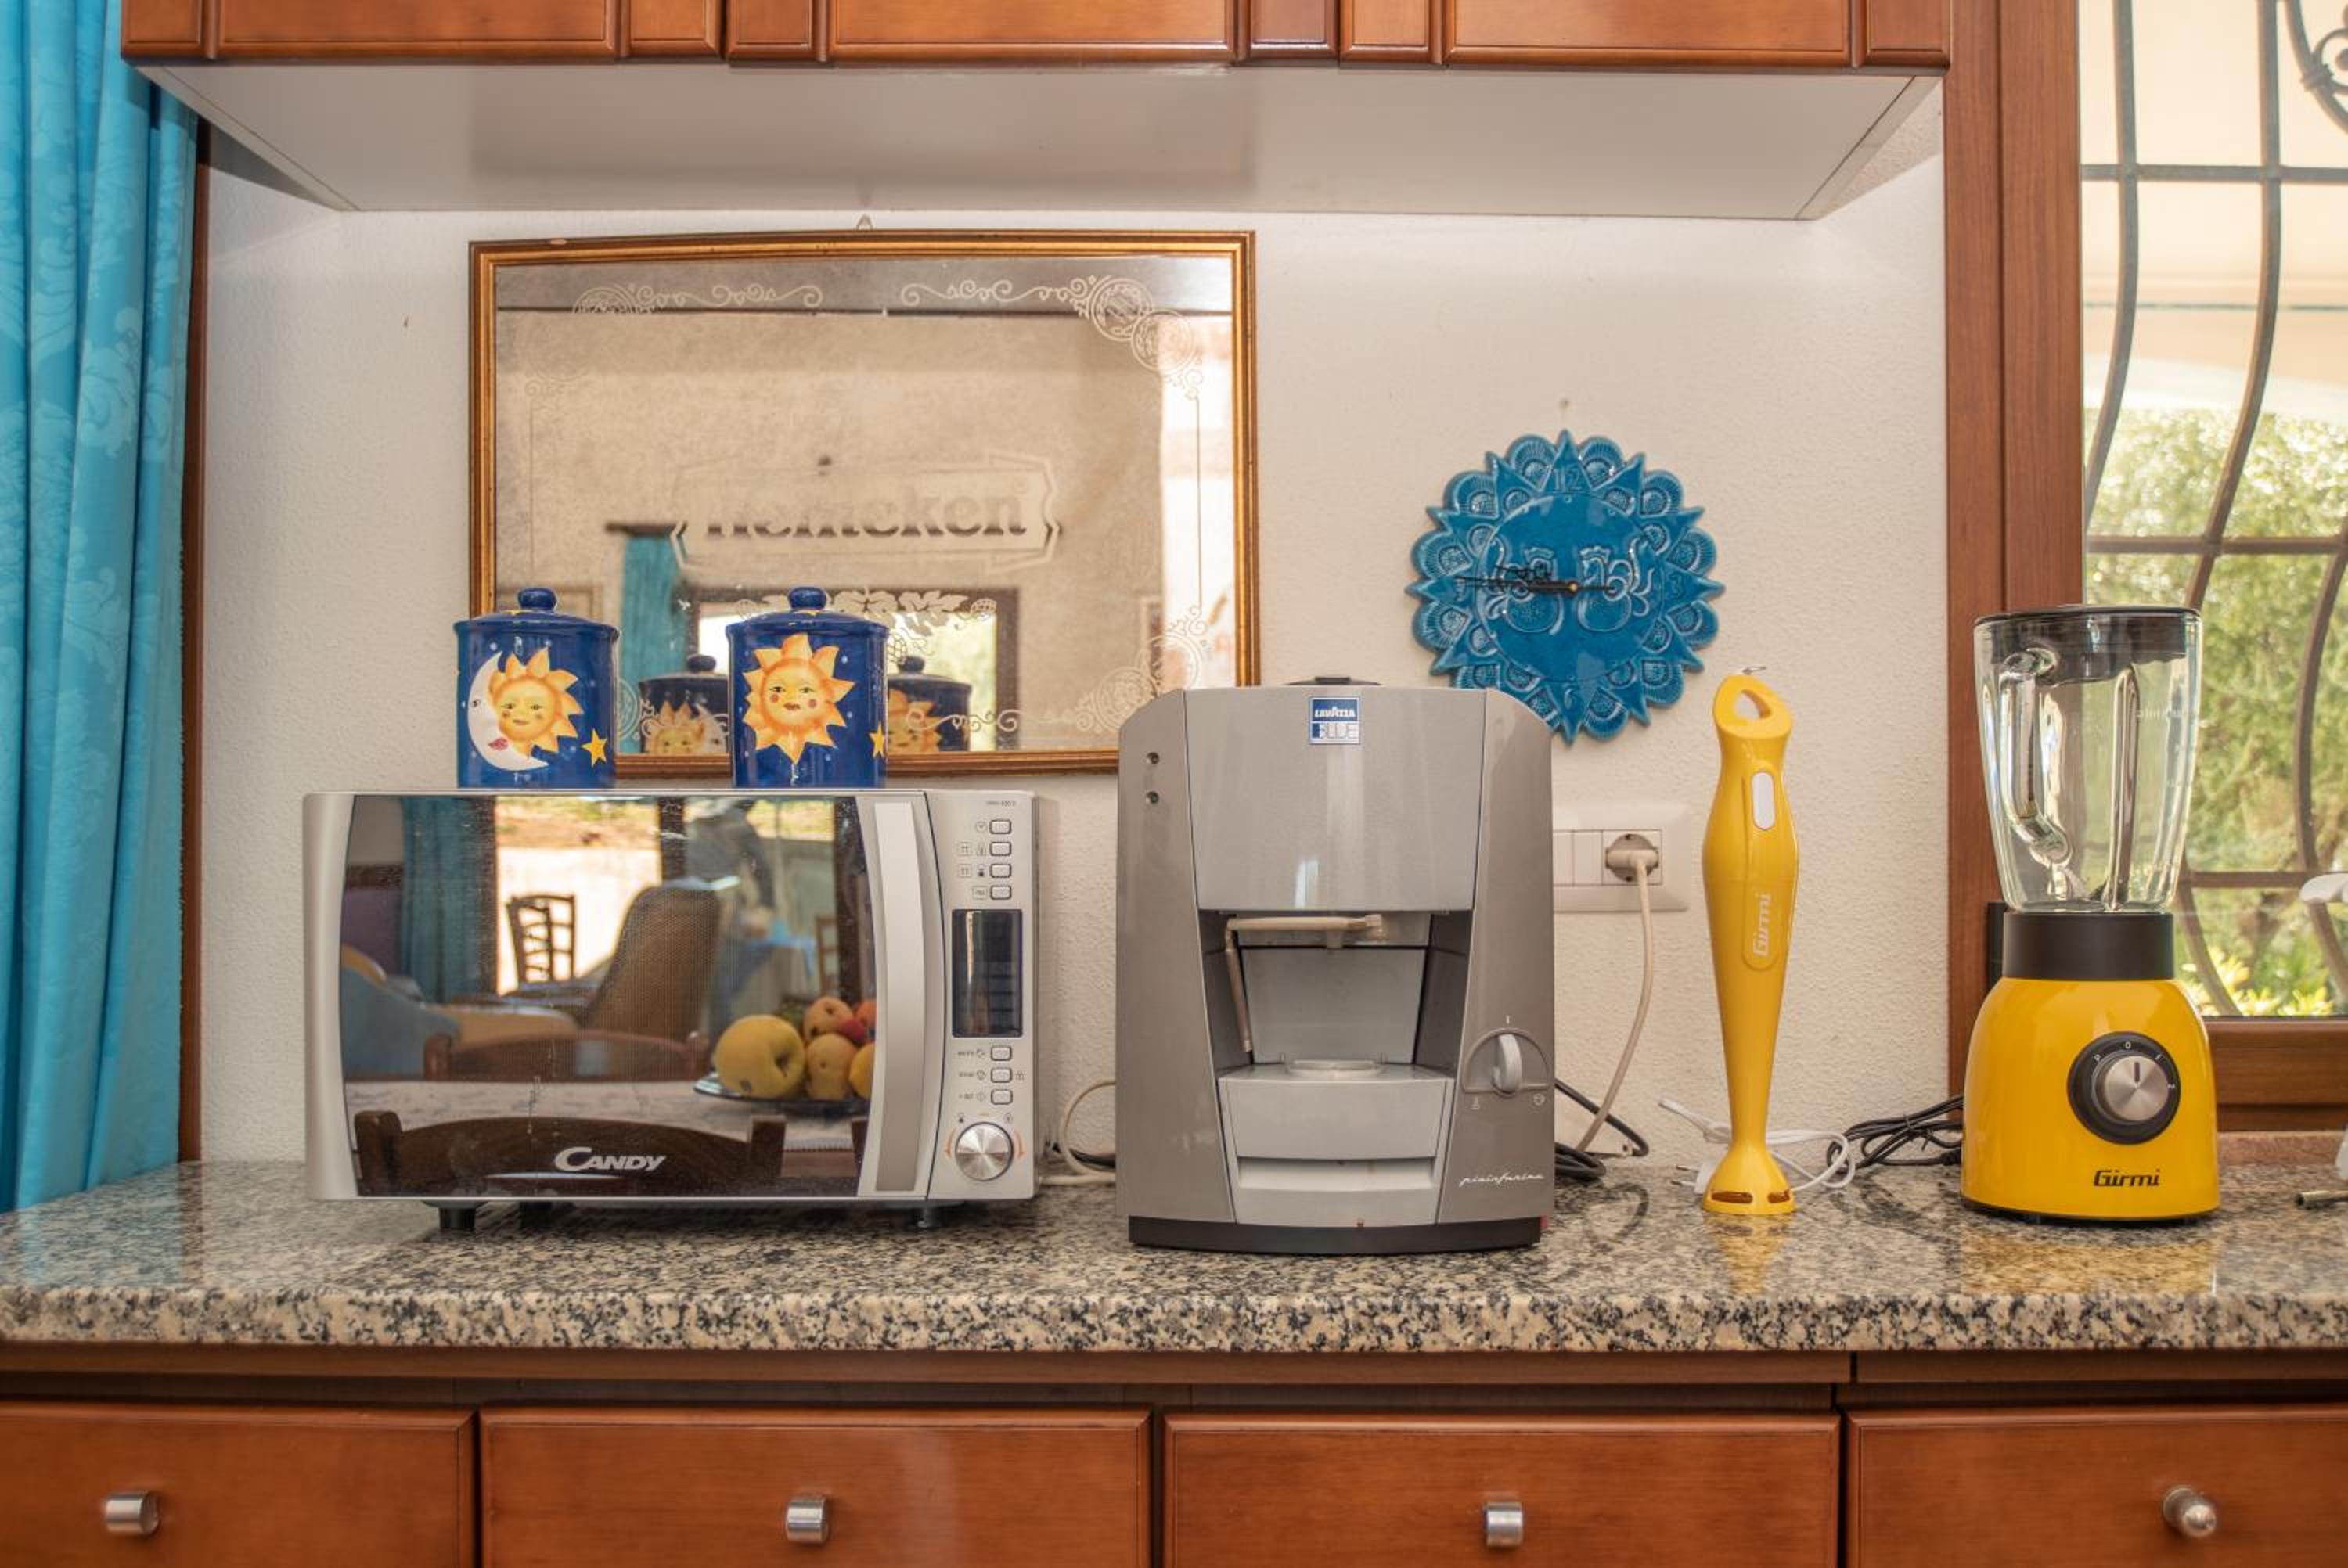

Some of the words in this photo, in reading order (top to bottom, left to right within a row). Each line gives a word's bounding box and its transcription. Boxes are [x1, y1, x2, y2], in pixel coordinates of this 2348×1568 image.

[1314, 706, 1356, 717] LAVAZZA
[1752, 894, 1772, 955] Girmi
[554, 1145, 667, 1171] CANDY
[2094, 1169, 2161, 1187] Girmi
